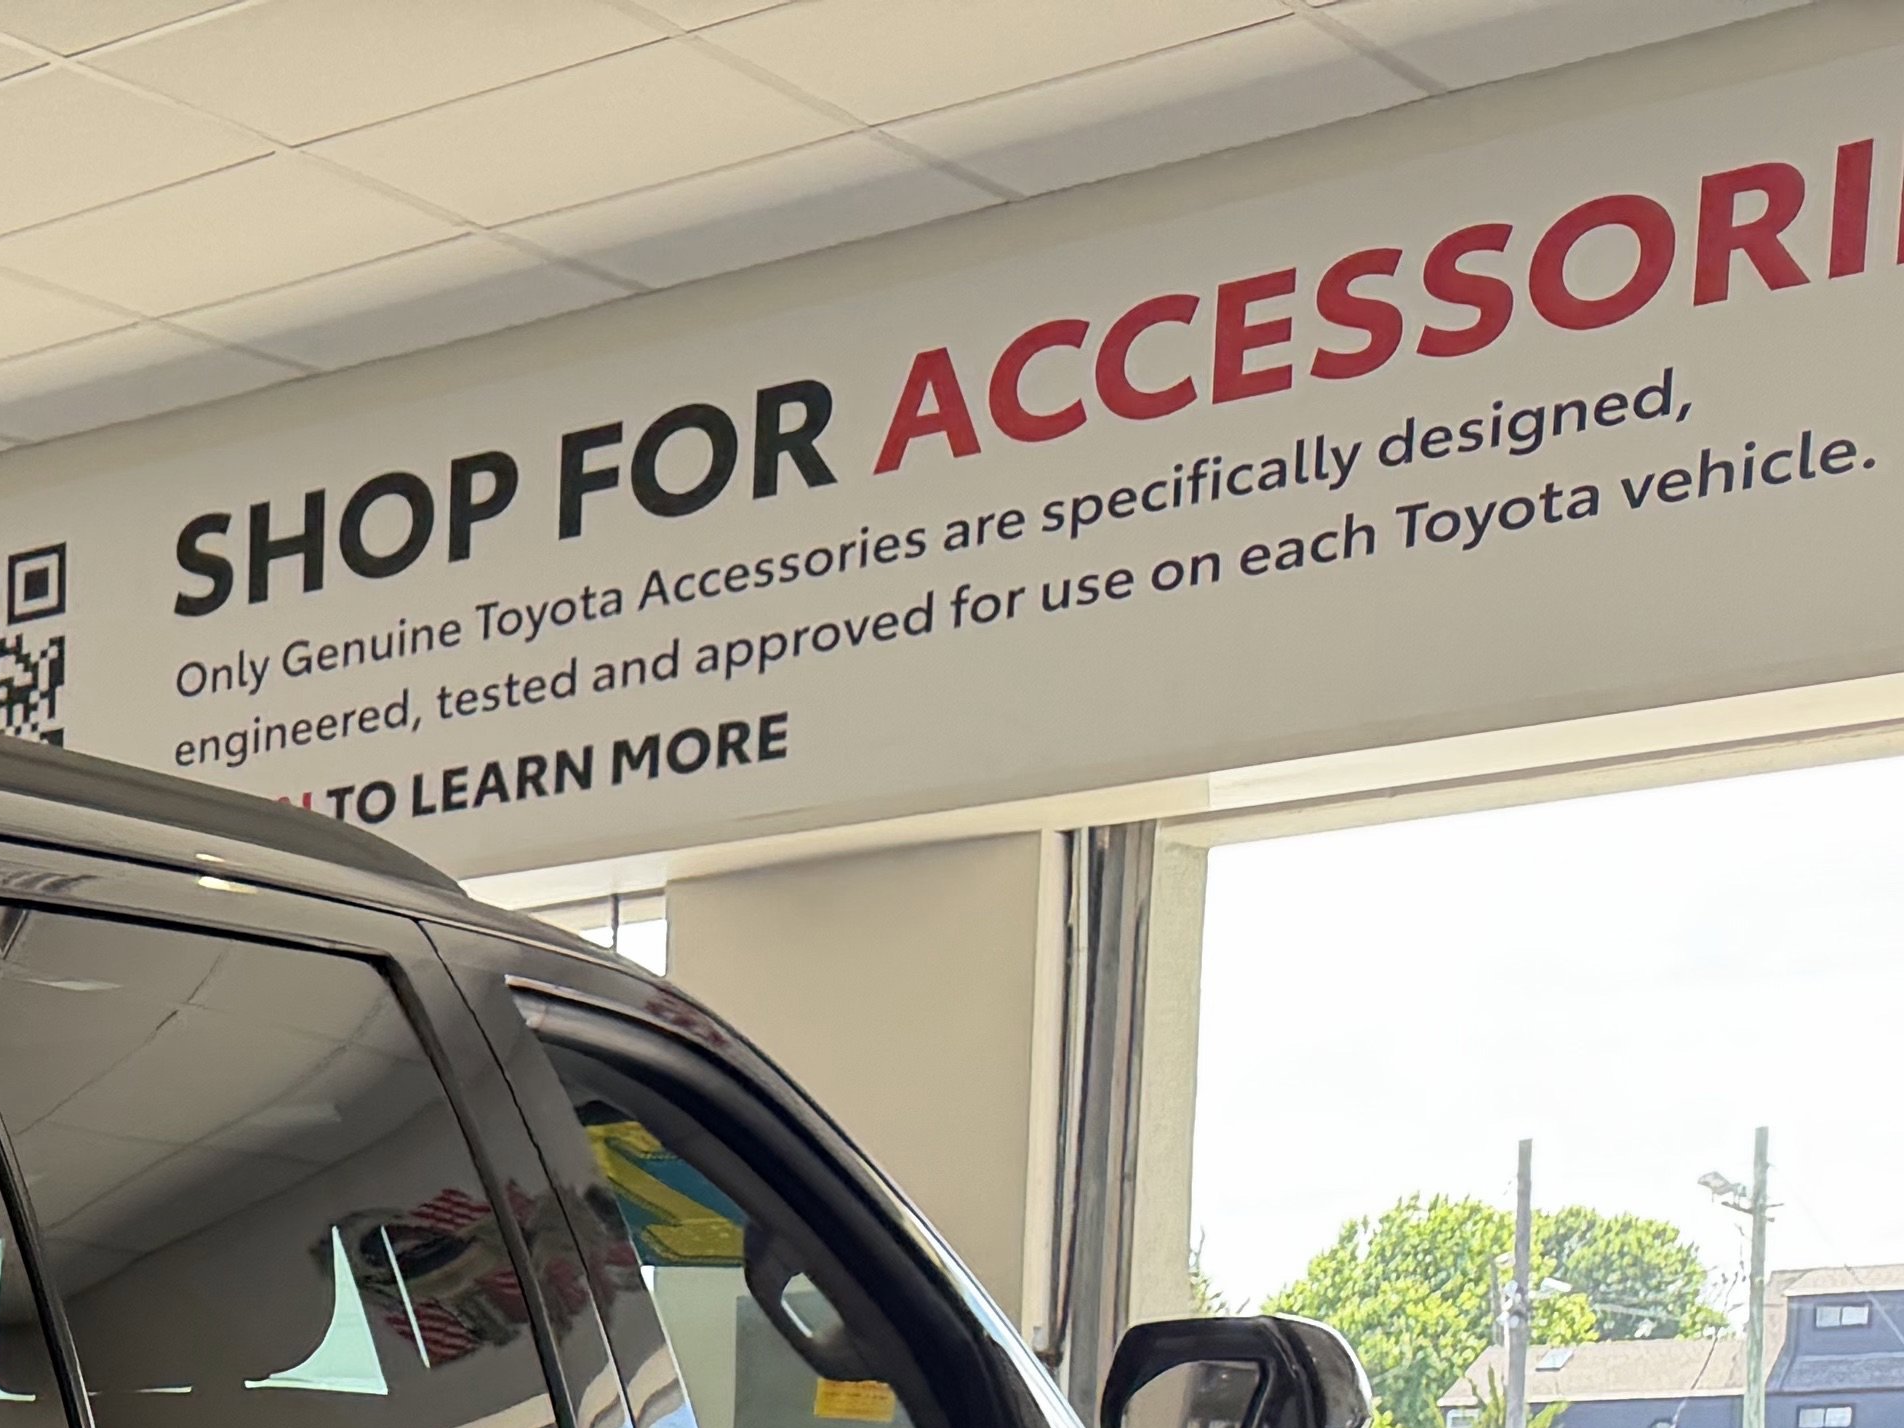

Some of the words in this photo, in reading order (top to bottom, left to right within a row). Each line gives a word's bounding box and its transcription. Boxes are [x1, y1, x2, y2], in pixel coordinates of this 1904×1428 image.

[174, 449, 519, 618] SHOP
[558, 378, 839, 541] FOR
[873, 137, 1904, 476] ACCESSORI
[175, 652, 270, 699] Only
[282, 616, 463, 678] Genuine
[475, 584, 624, 643] Toyota
[638, 525, 927, 612] Accessories
[944, 507, 1026, 553] are
[1040, 433, 1363, 539] specifically
[1377, 366, 1693, 468] designed,
[173, 689, 424, 769] engineered,
[436, 658, 578, 719] tested
[592, 638, 681, 694] and
[695, 589, 935, 676] approved
[949, 582, 1026, 629] for
[1040, 567, 1134, 613] use
[1150, 550, 1222, 592] on
[1239, 512, 1376, 577] each
[1395, 481, 1600, 552] Toyota
[1620, 429, 1877, 510] vehicle.
[326, 779, 397, 825] TO
[411, 746, 594, 818] LEARN
[611, 712, 790, 786] MORE
